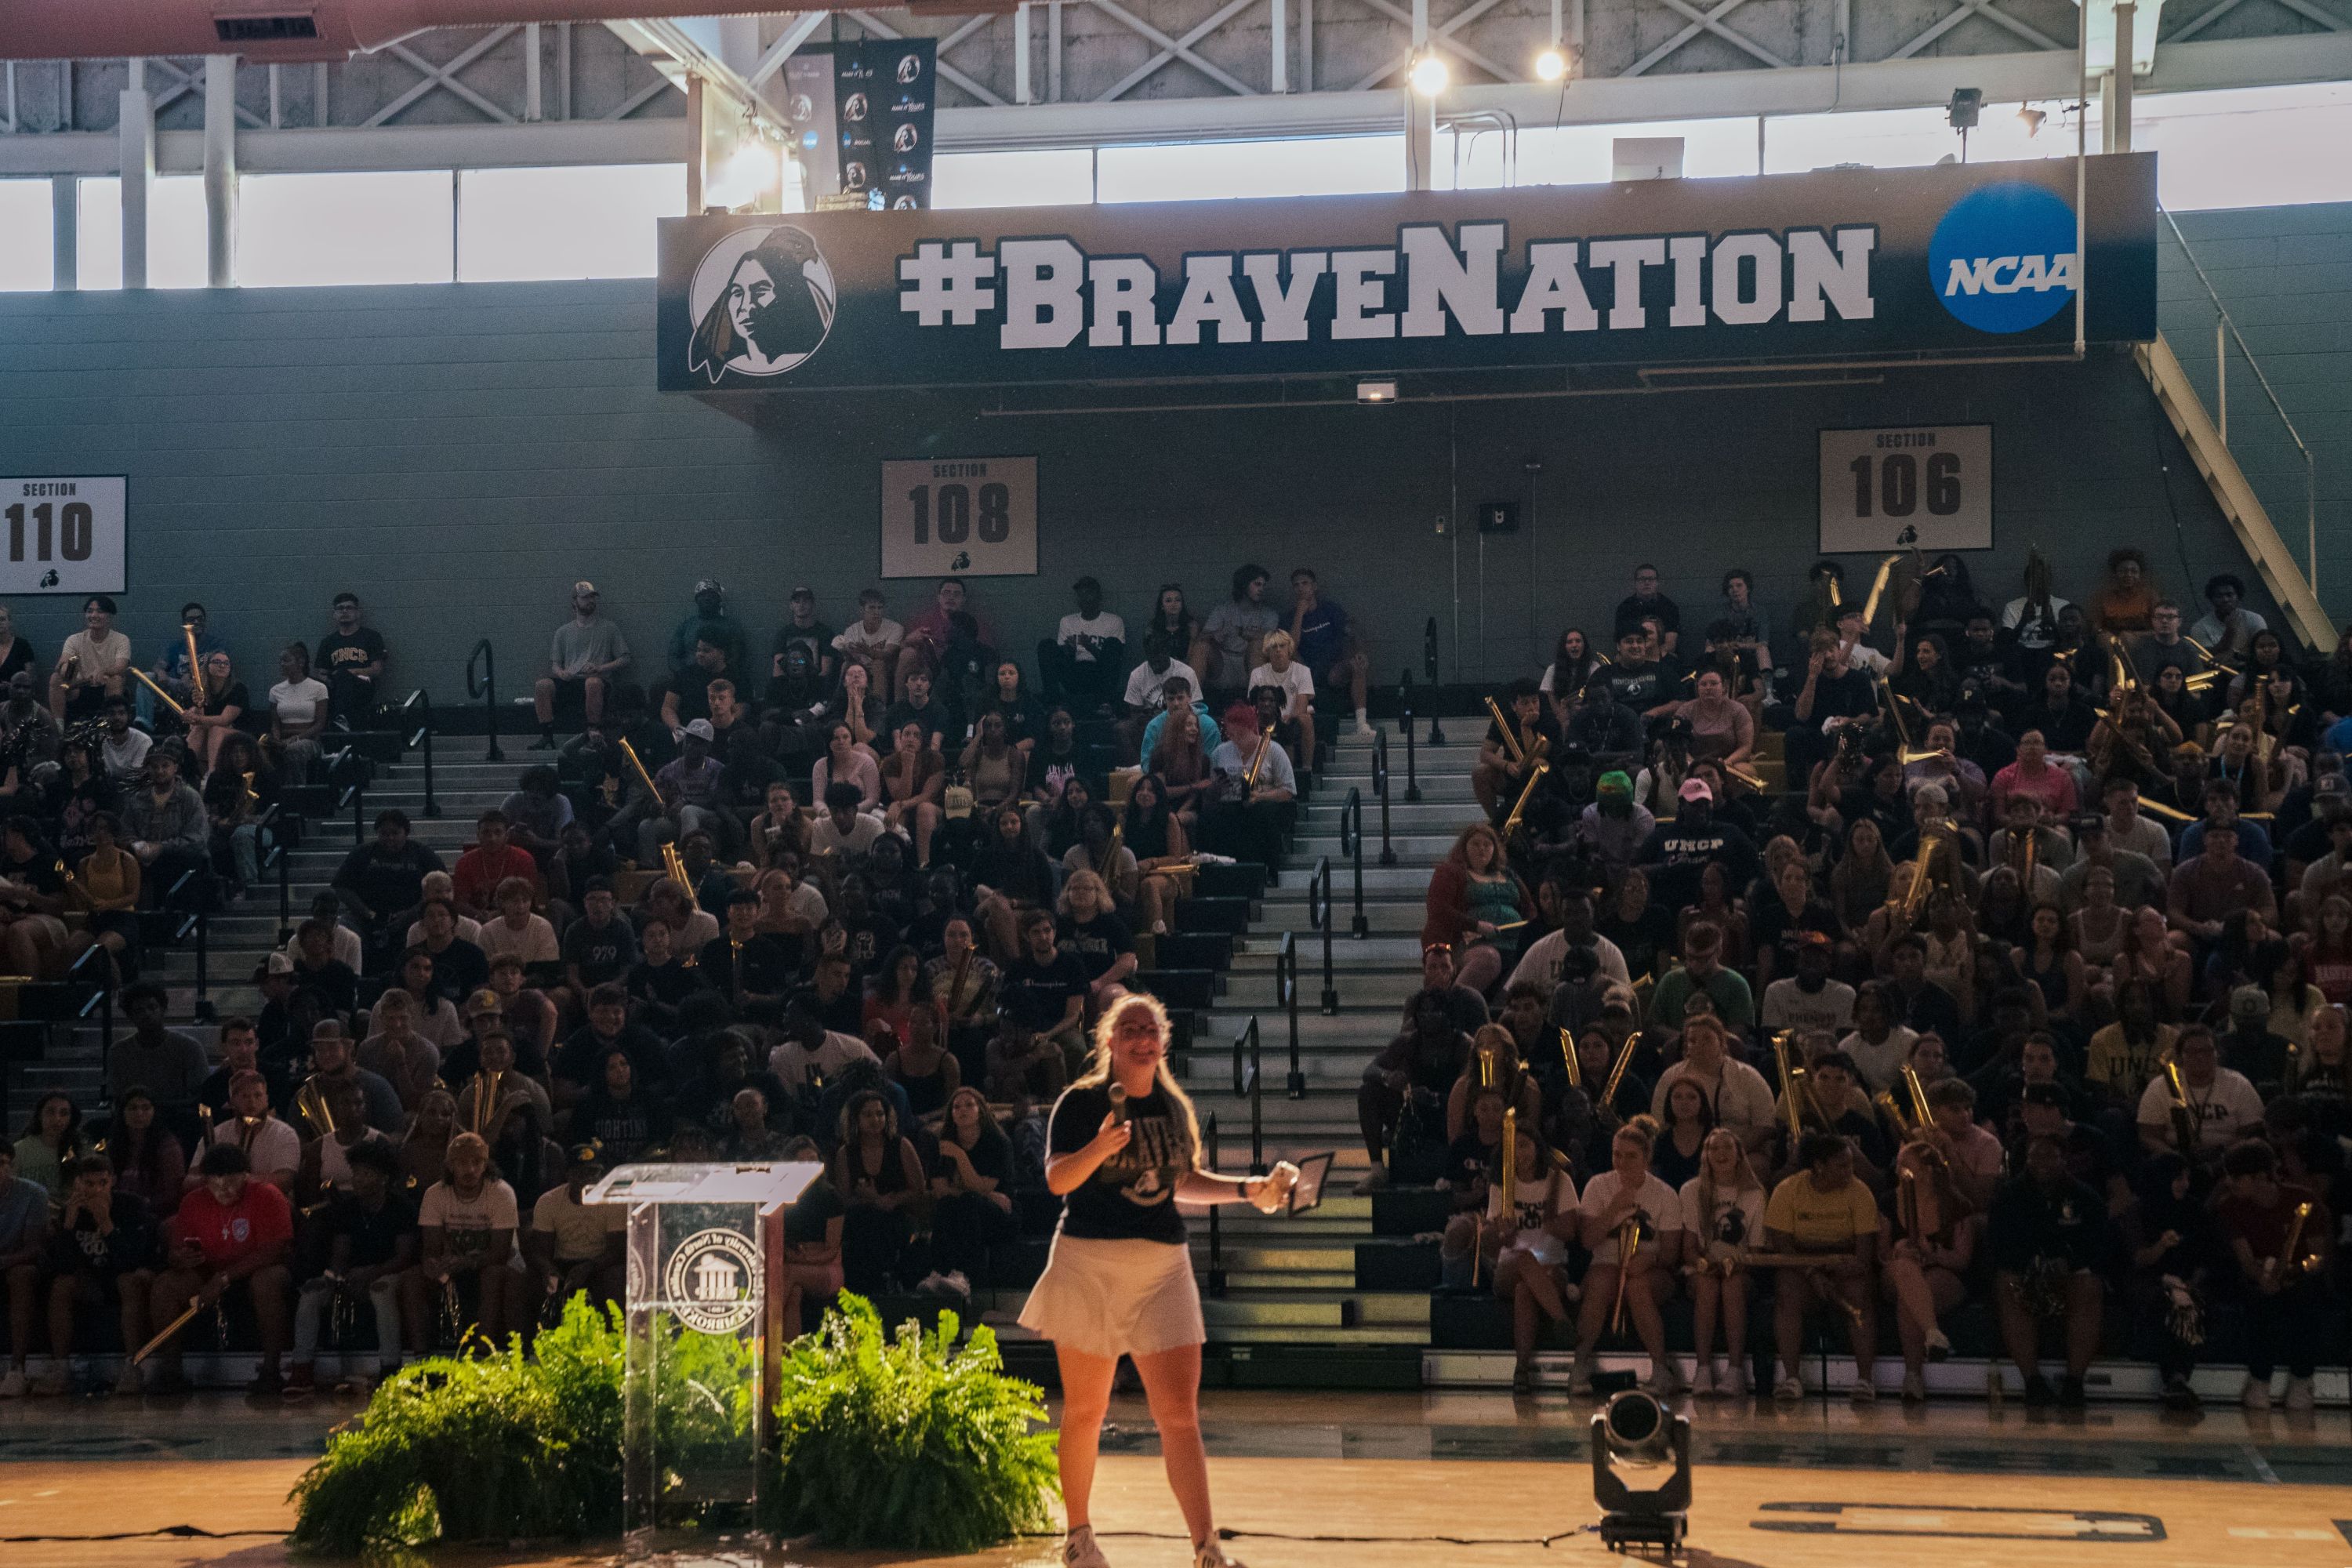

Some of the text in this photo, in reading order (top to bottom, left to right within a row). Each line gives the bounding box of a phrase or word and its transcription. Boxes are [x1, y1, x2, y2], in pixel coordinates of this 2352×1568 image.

[1944, 252, 2077, 297] NCAA
[1877, 433, 1936, 448] SECTION
[933, 464, 987, 477] SECTION
[1850, 452, 1962, 518] 106
[23, 483, 76, 496] SECTION
[909, 483, 1010, 546] 108
[5, 502, 92, 562] 110
[1664, 838, 1724, 852] UNCP
